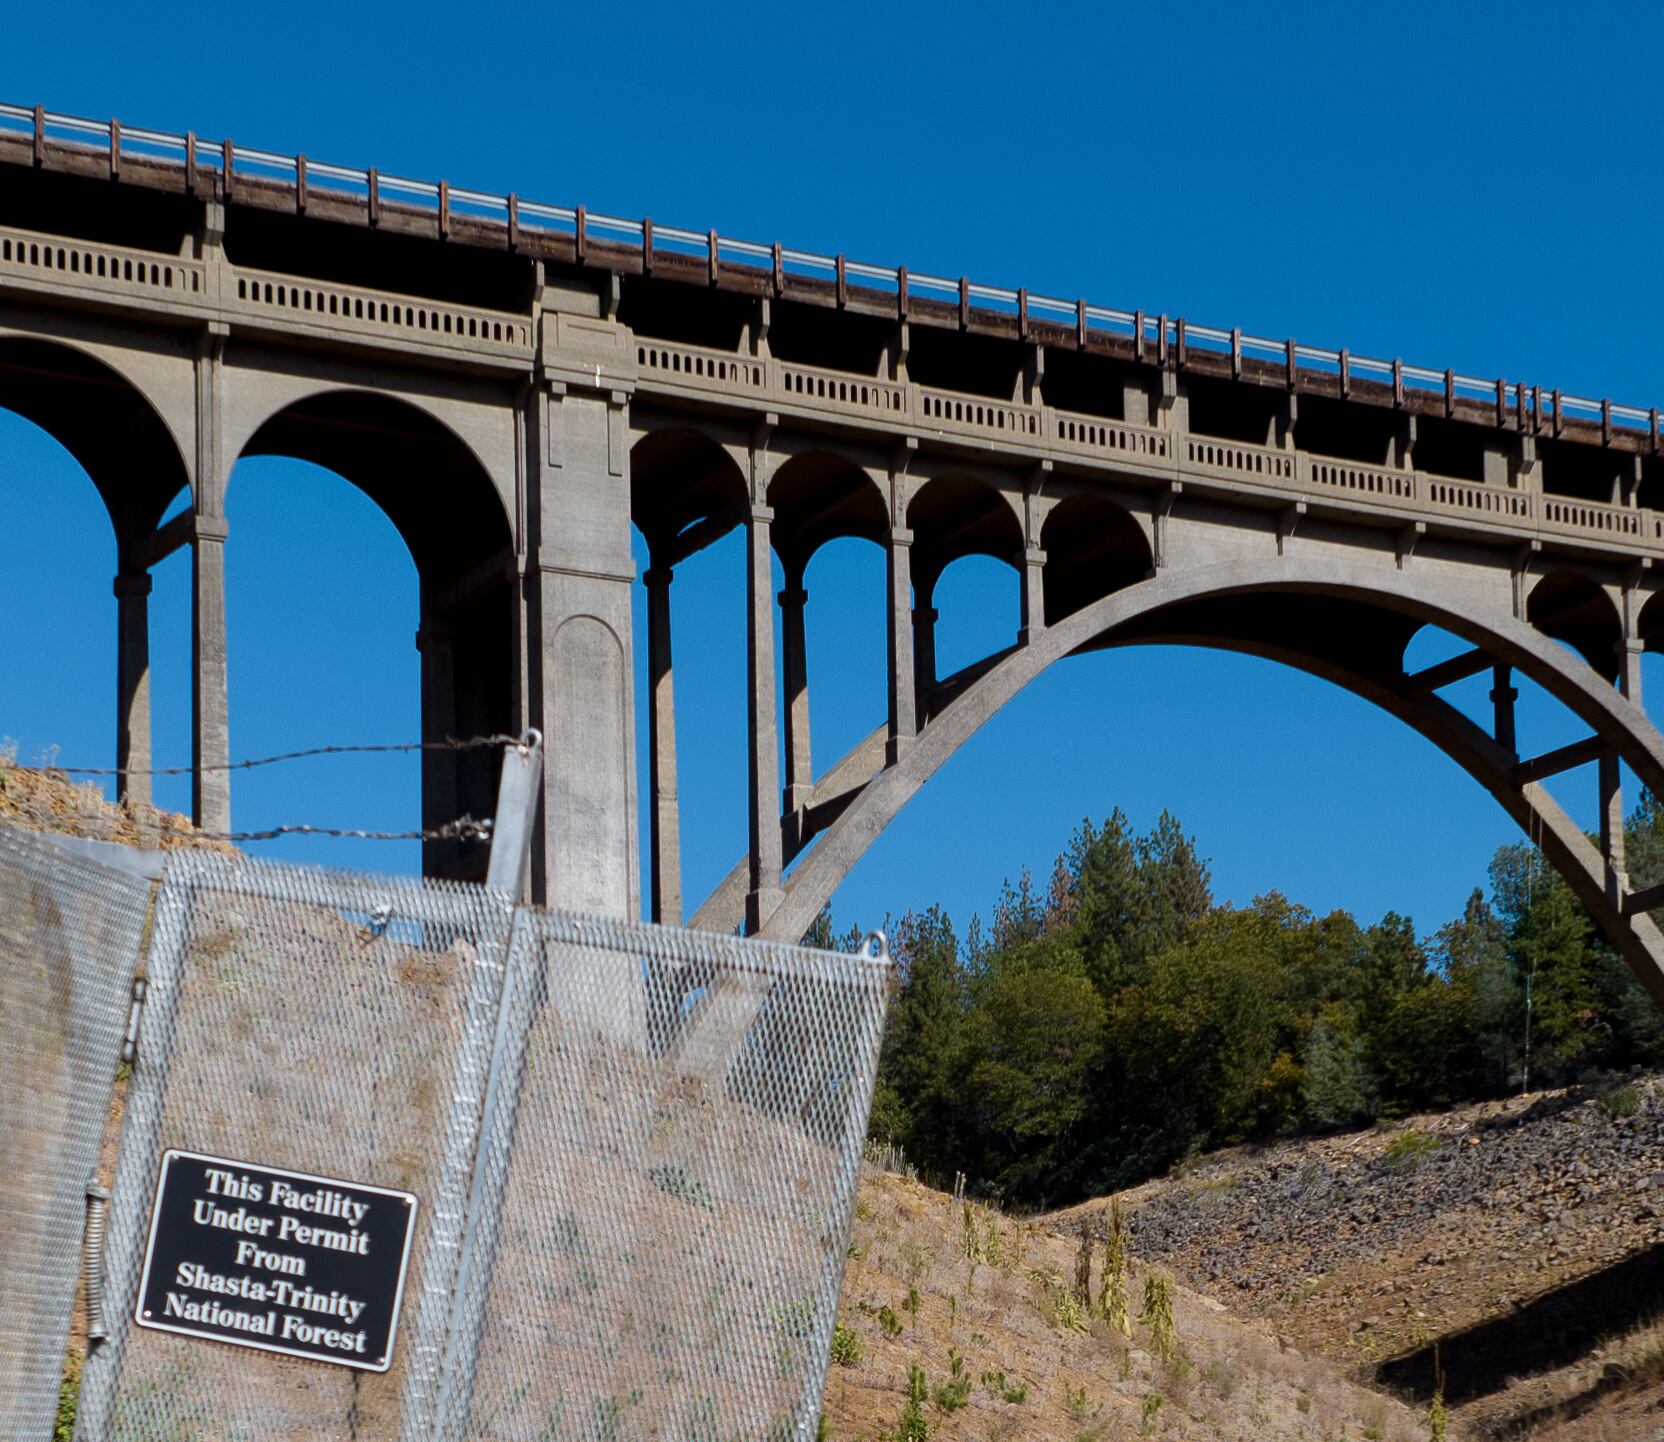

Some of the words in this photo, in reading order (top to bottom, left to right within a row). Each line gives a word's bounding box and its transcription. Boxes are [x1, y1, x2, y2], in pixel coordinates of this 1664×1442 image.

[205, 1168, 264, 1203] This
[268, 1180, 370, 1226] Facility
[192, 1199, 274, 1237] Under
[277, 1215, 370, 1255] Permit
[234, 1240, 306, 1276] From
[176, 1262, 366, 1324] Shasta-Trinity
[162, 1292, 276, 1336] National
[281, 1314, 367, 1353] Forest
